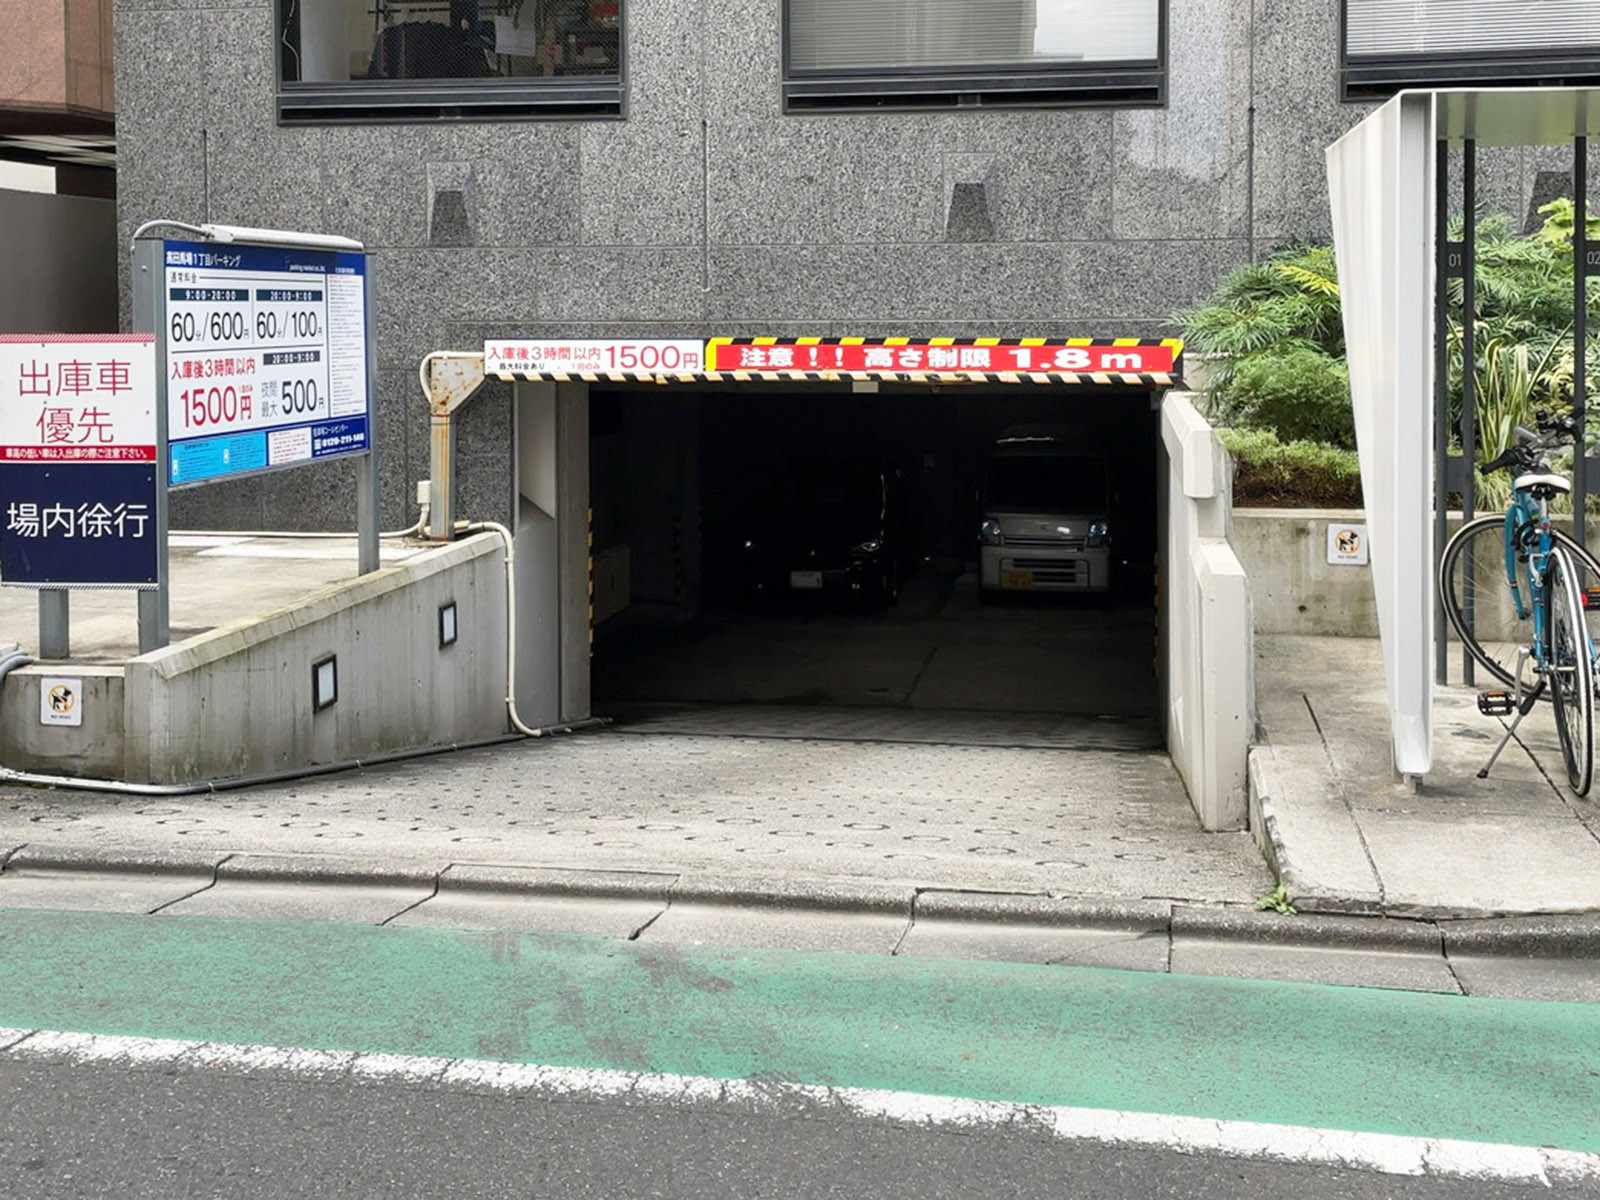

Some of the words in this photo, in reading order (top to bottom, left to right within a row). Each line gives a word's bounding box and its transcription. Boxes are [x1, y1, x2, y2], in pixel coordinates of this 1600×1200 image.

[1448, 253, 1462, 268] 01
[171, 357, 256, 380] 入庫後3時間以内
[487, 345, 601, 361] 入庫後3時間以内
[604, 345, 699, 369] 1500円
[499, 361, 545, 370] 最大料金あり
[863, 347, 991, 369] 高さ制限
[19, 359, 133, 397] 出庫車
[180, 385, 253, 428] 1500円
[281, 378, 325, 416] 500円
[36, 406, 114, 444] 優先
[6, 502, 149, 538] 場内徐行
